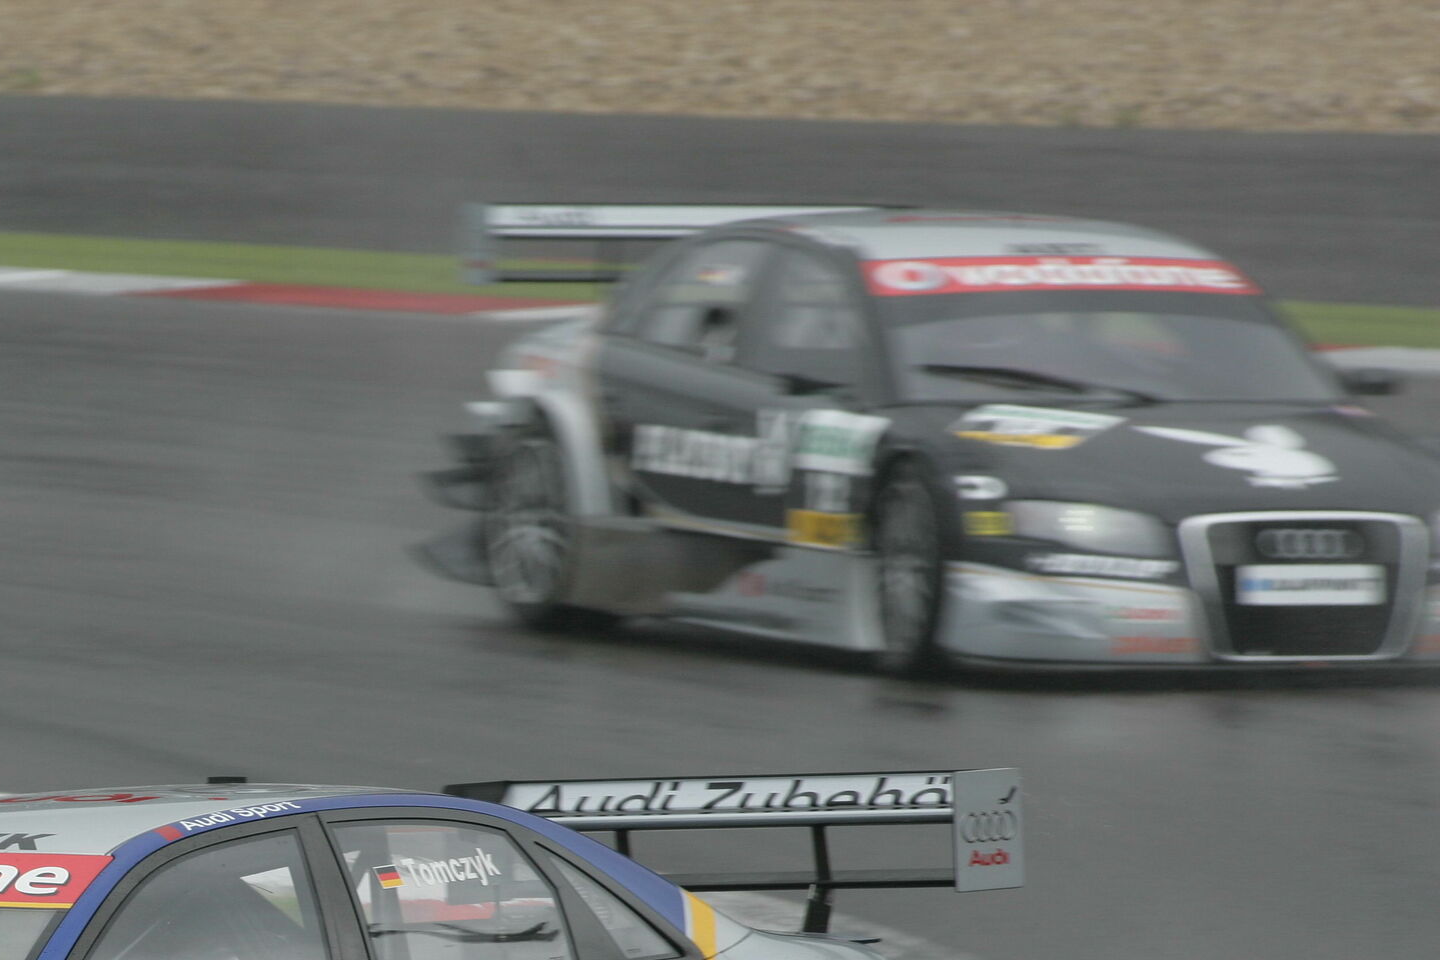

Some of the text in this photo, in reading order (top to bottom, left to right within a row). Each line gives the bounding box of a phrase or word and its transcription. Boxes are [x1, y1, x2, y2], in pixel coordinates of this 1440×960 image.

[530, 775, 951, 813] Audi Zubehö
[180, 800, 302, 831] Audi Sport
[400, 848, 502, 887] Tomczyk
[968, 848, 1010, 868] Audi
